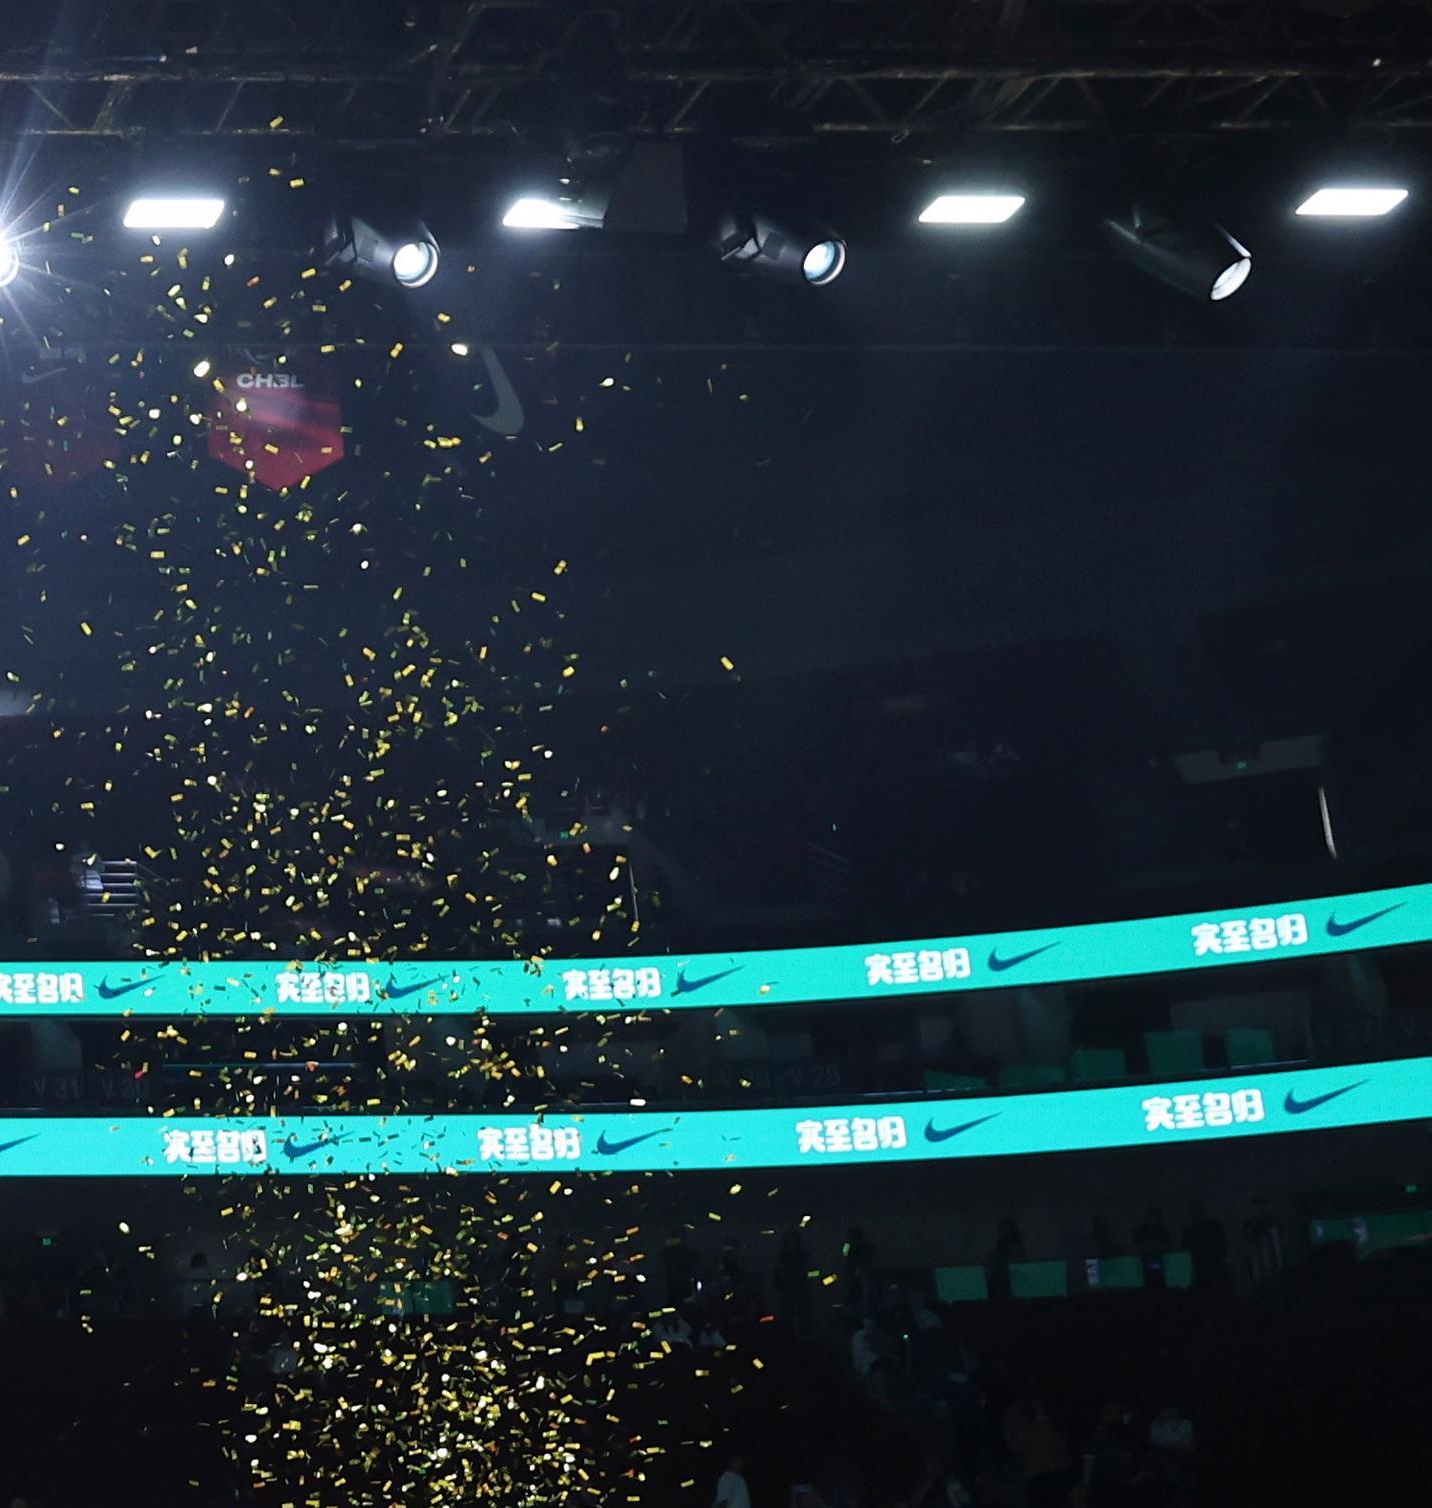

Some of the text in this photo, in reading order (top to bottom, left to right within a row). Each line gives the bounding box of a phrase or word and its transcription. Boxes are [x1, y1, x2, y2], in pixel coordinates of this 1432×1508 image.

[1192, 914, 1307, 955] 实至名归
[564, 968, 661, 1000] 实至名归
[865, 950, 971, 985] 实至名归
[275, 972, 371, 1003] 实至名归
[1143, 1089, 1264, 1130] 实至名归
[162, 1130, 266, 1164] 实至名归
[478, 1126, 581, 1160] 实至名归
[796, 1117, 906, 1152] 实至名归
